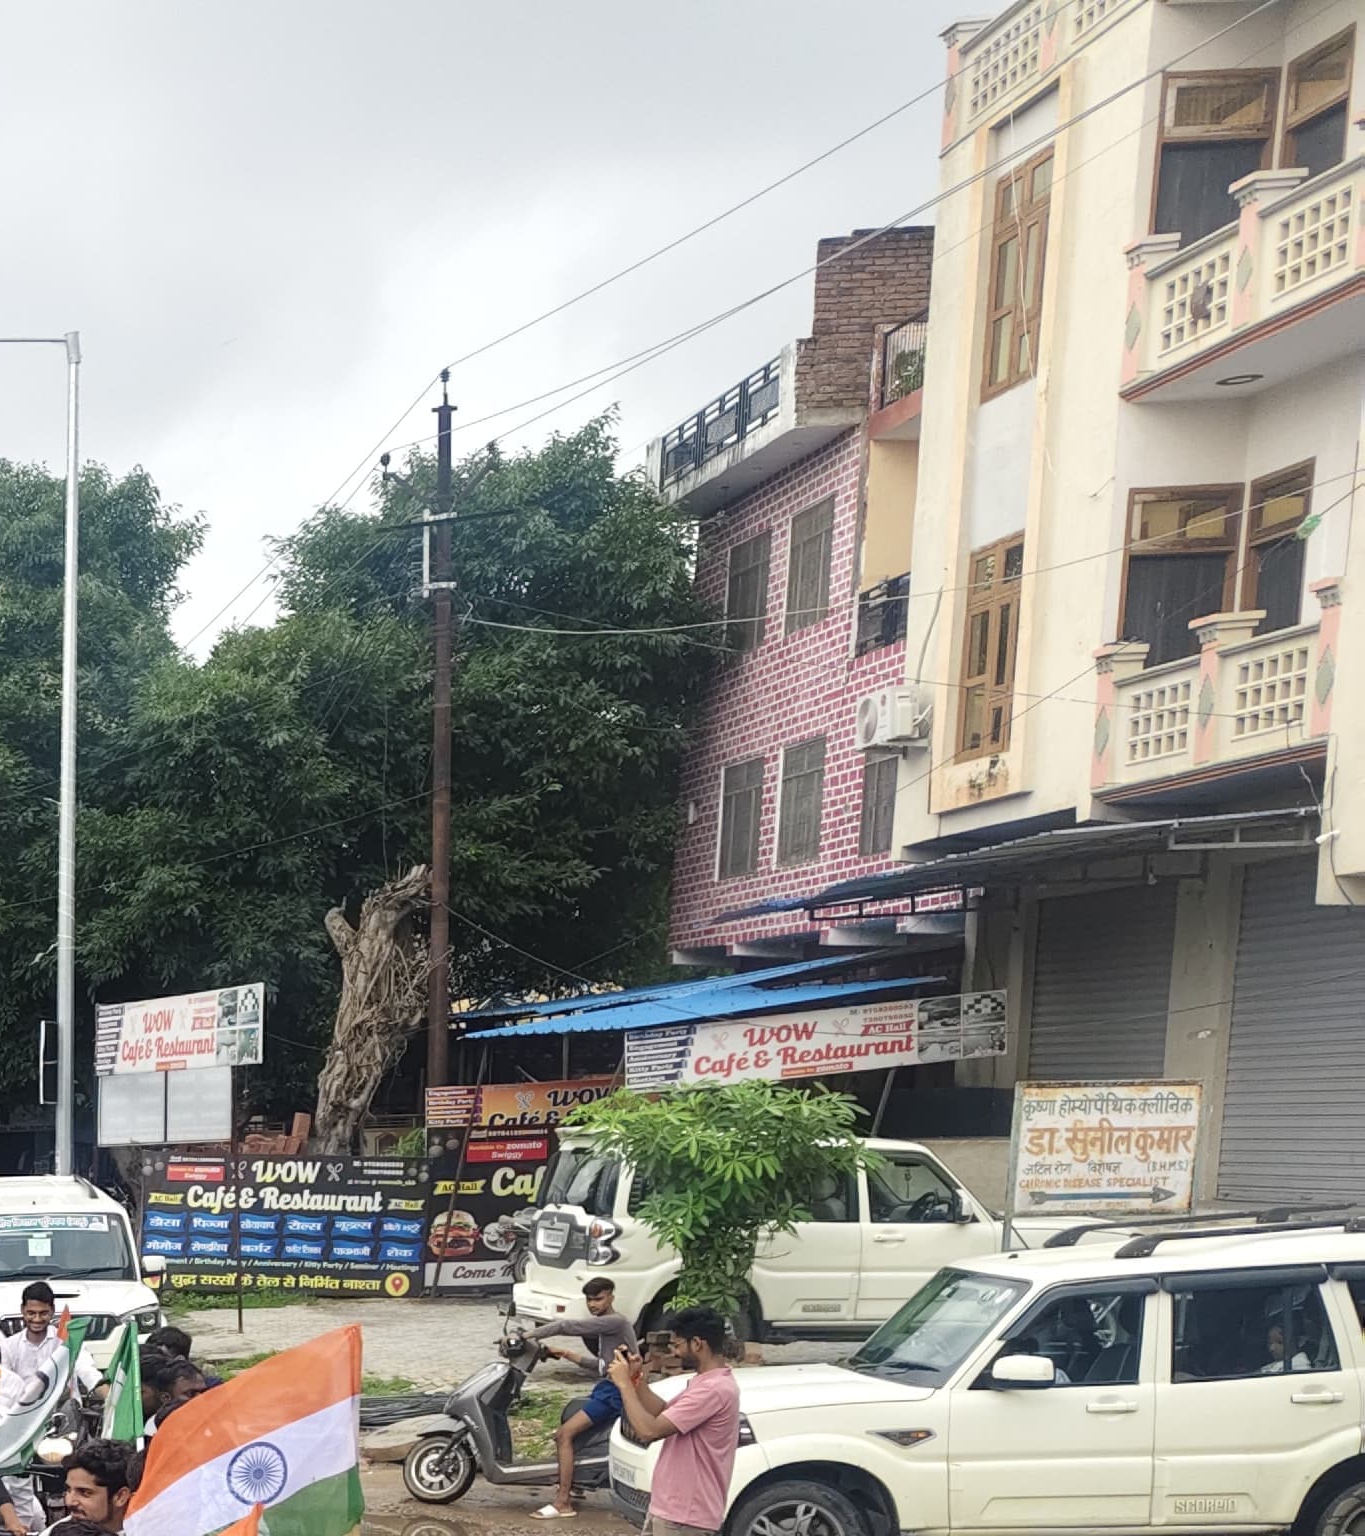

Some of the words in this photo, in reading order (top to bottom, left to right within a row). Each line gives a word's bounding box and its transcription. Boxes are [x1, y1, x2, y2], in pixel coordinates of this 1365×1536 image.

[143, 1007, 175, 1034] WOW
[869, 1025, 883, 1035] AC
[885, 1022, 907, 1033] Hall
[743, 1020, 818, 1048] WOW
[121, 1037, 144, 1066] Café
[145, 1039, 153, 1059] &
[155, 1032, 215, 1060] Restaurant
[694, 1051, 751, 1078] Café
[753, 1049, 773, 1069] &
[776, 1033, 915, 1066] Restaurant
[488, 1110, 541, 1126] Café
[506, 1140, 543, 1151] zomato
[1134, 1124, 1196, 1163] कुमार
[251, 1160, 322, 1184] WOW
[1062, 1176, 1103, 1190] DISEASE
[1105, 1175, 1171, 1190] SPECIALIST
[491, 1166, 547, 1203] Caf
[186, 1185, 236, 1214] Café
[238, 1187, 258, 1209] &
[258, 1186, 383, 1213] Restaurant
[282, 1274, 297, 1288] से
[452, 1265, 497, 1280] Come
[1174, 1498, 1238, 1514] SCORPIO
